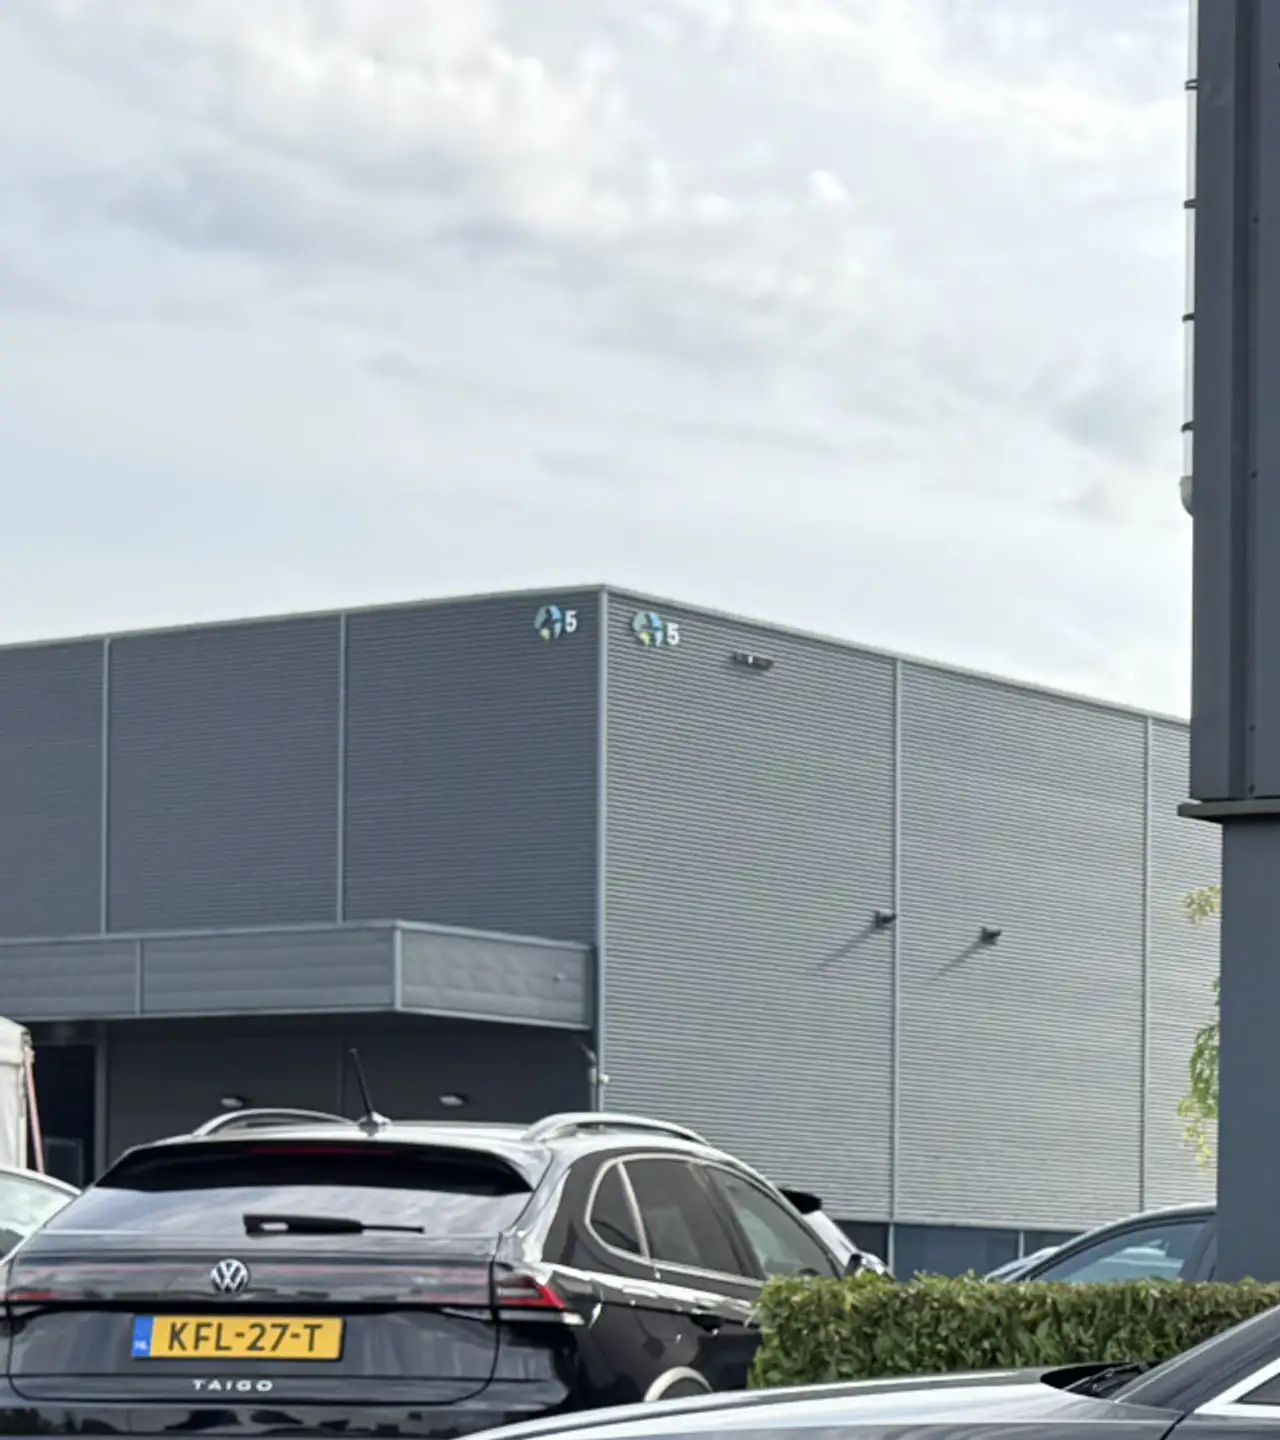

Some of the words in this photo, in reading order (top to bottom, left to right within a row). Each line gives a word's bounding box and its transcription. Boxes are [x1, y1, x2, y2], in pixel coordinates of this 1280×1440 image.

[564, 610, 577, 633] 5
[666, 622, 680, 646] 5
[168, 1322, 324, 1352] KFL-27-T
[192, 1379, 273, 1392] TAIGO
